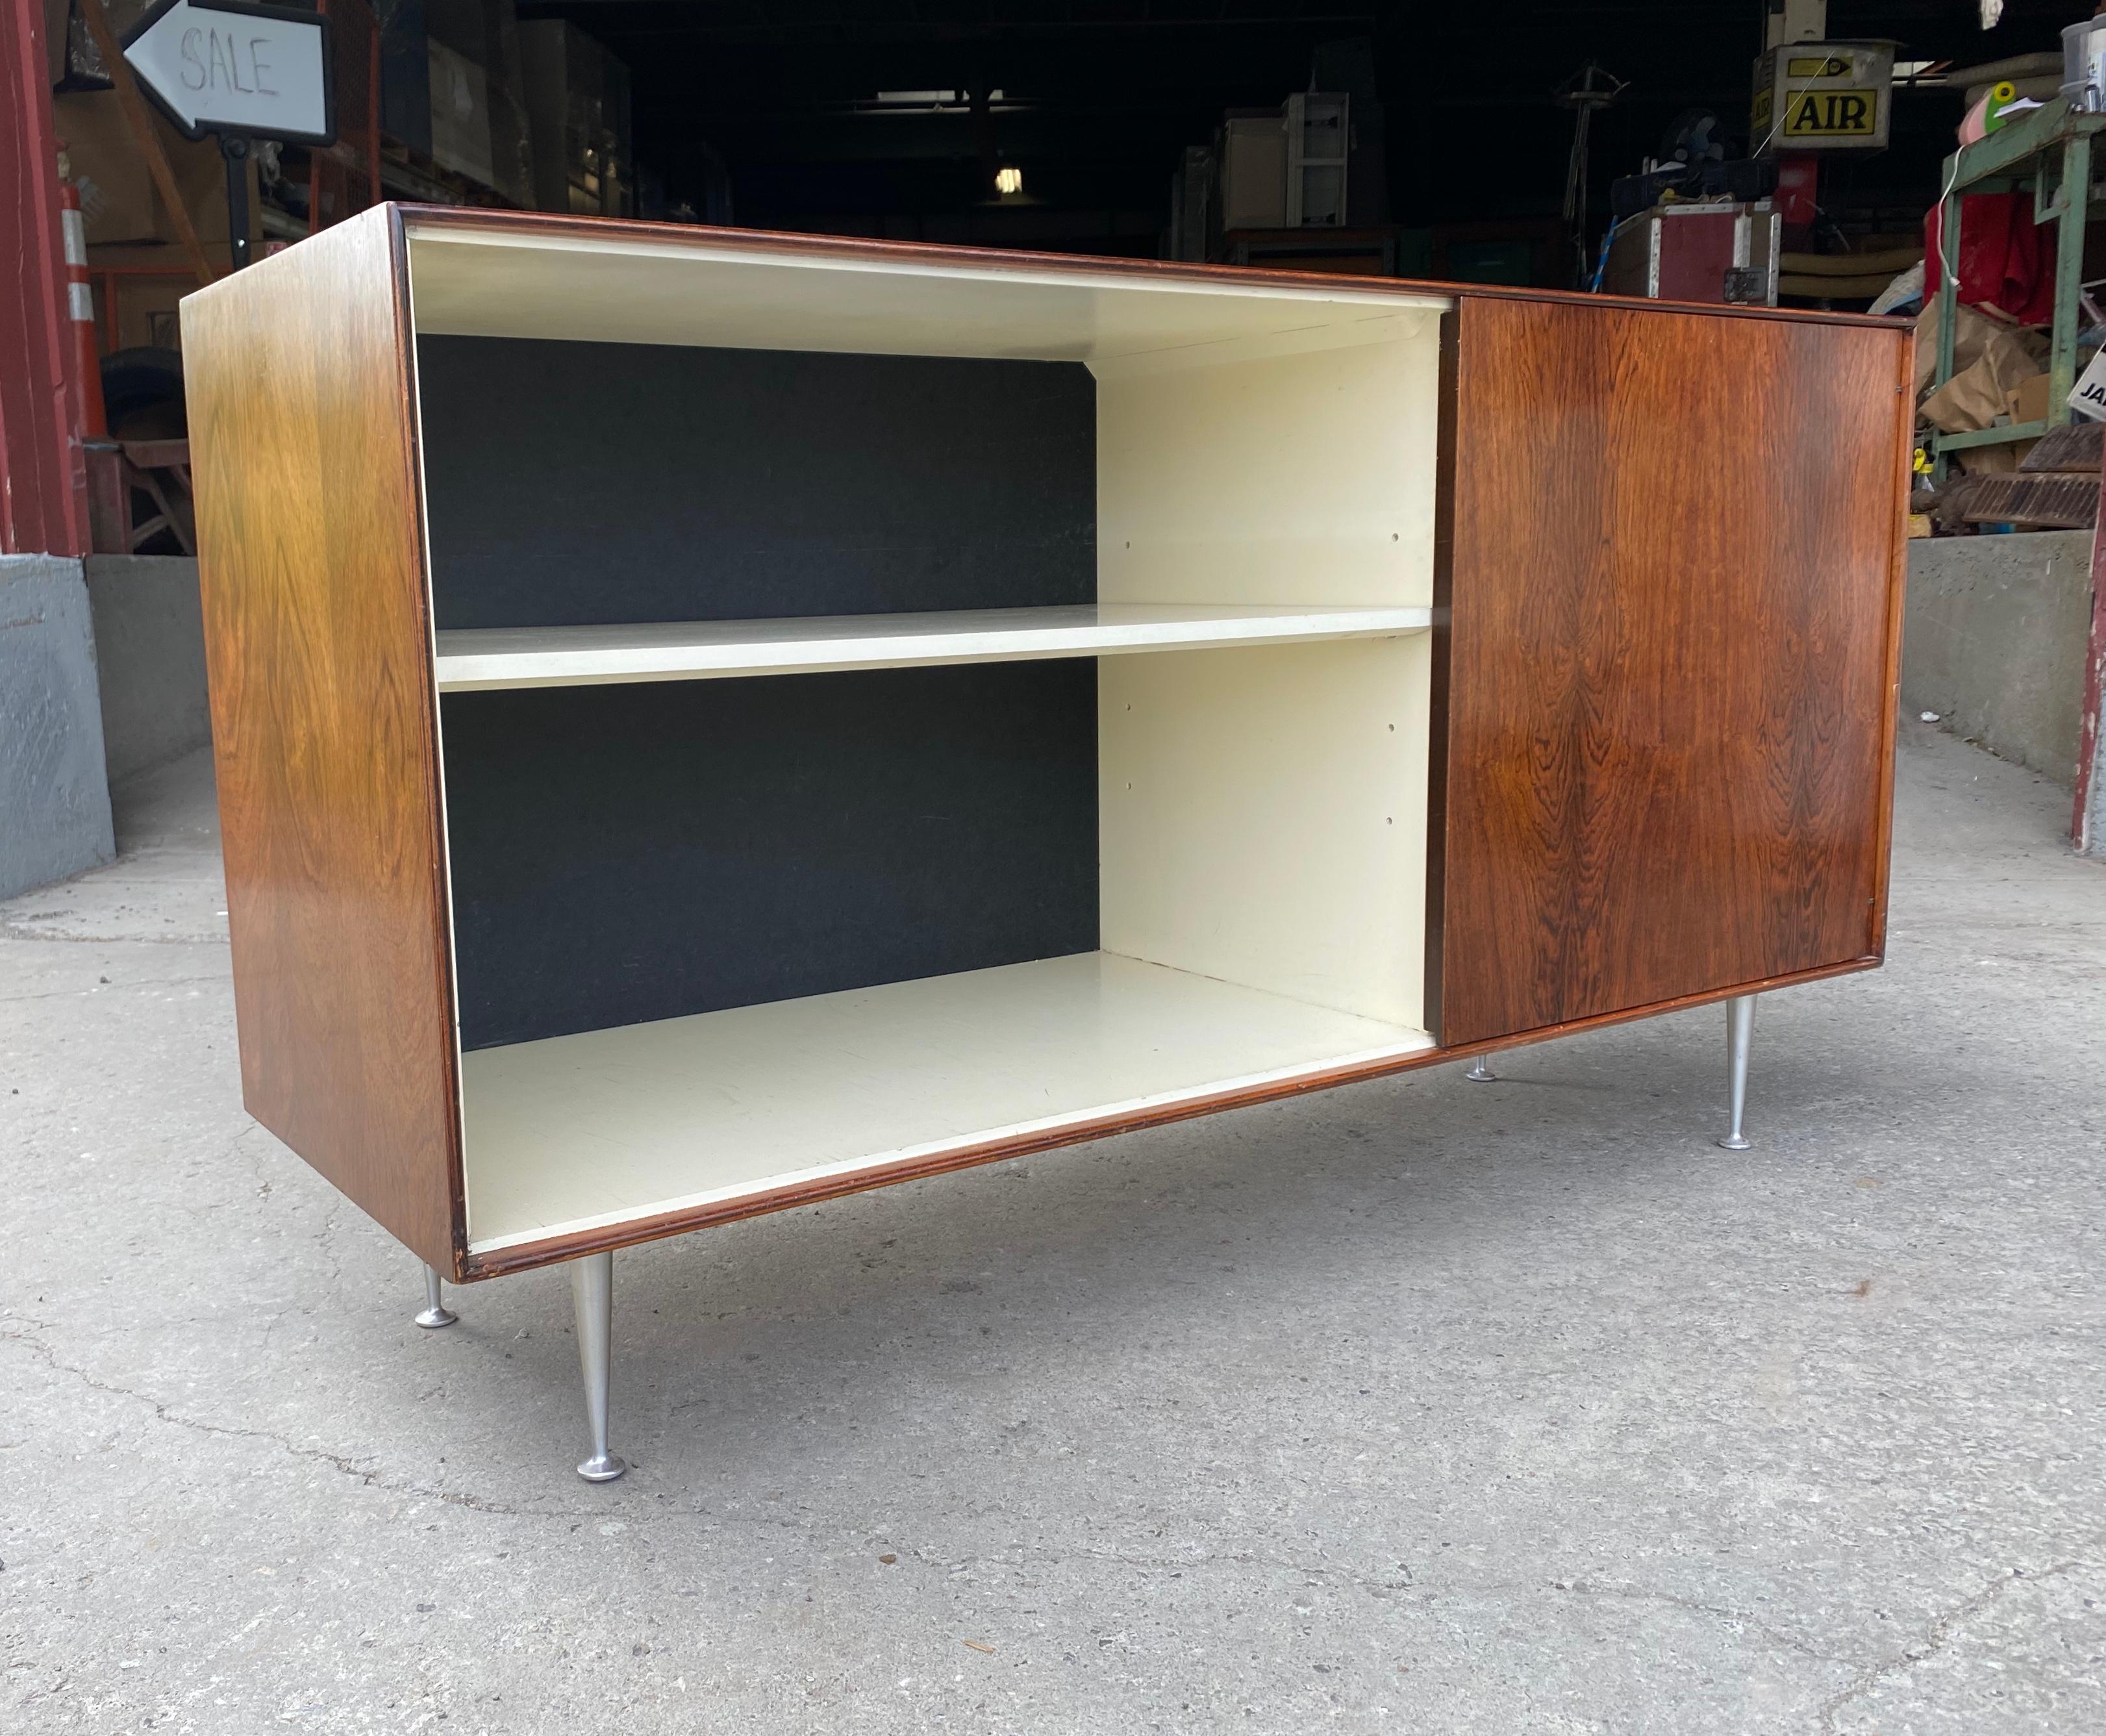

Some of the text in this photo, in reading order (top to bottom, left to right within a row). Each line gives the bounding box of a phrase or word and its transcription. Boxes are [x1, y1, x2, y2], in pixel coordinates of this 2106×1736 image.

[181, 27, 280, 97] SALE
[1755, 96, 1770, 120] AIR
[1793, 95, 1866, 129] AIR
[2081, 383, 2106, 406] JA
